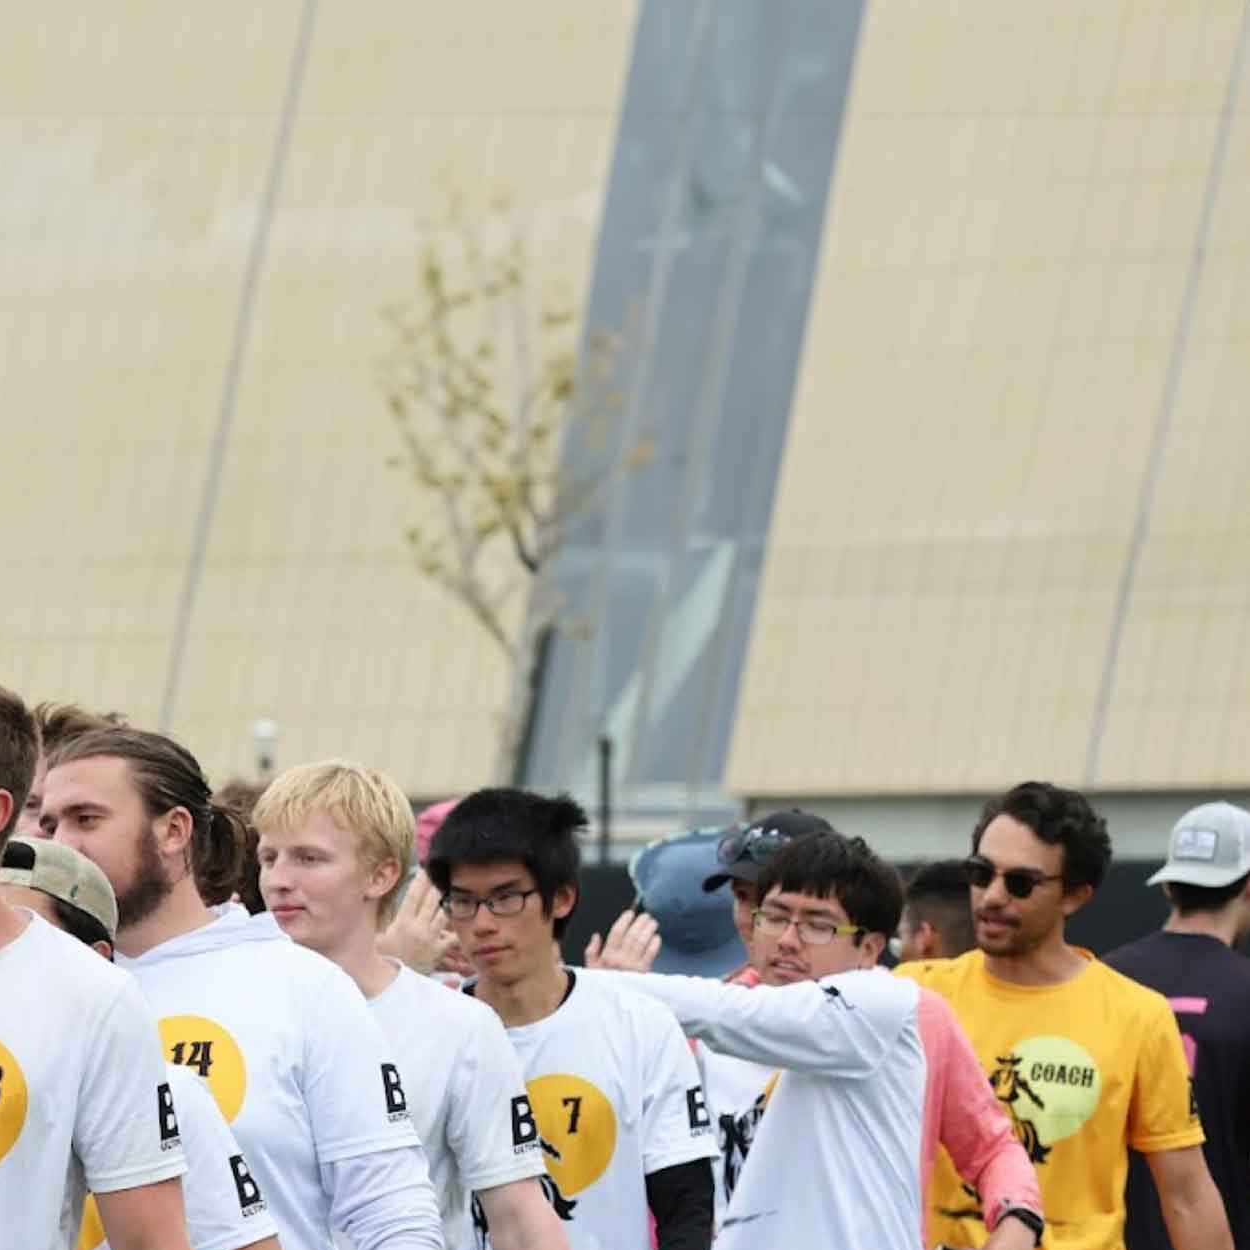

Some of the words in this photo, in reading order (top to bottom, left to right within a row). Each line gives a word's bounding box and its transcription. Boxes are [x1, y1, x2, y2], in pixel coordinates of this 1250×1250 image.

[171, 1041, 214, 1077] 14
[1030, 1063, 1094, 1088] COACH
[562, 1096, 582, 1134] 7
